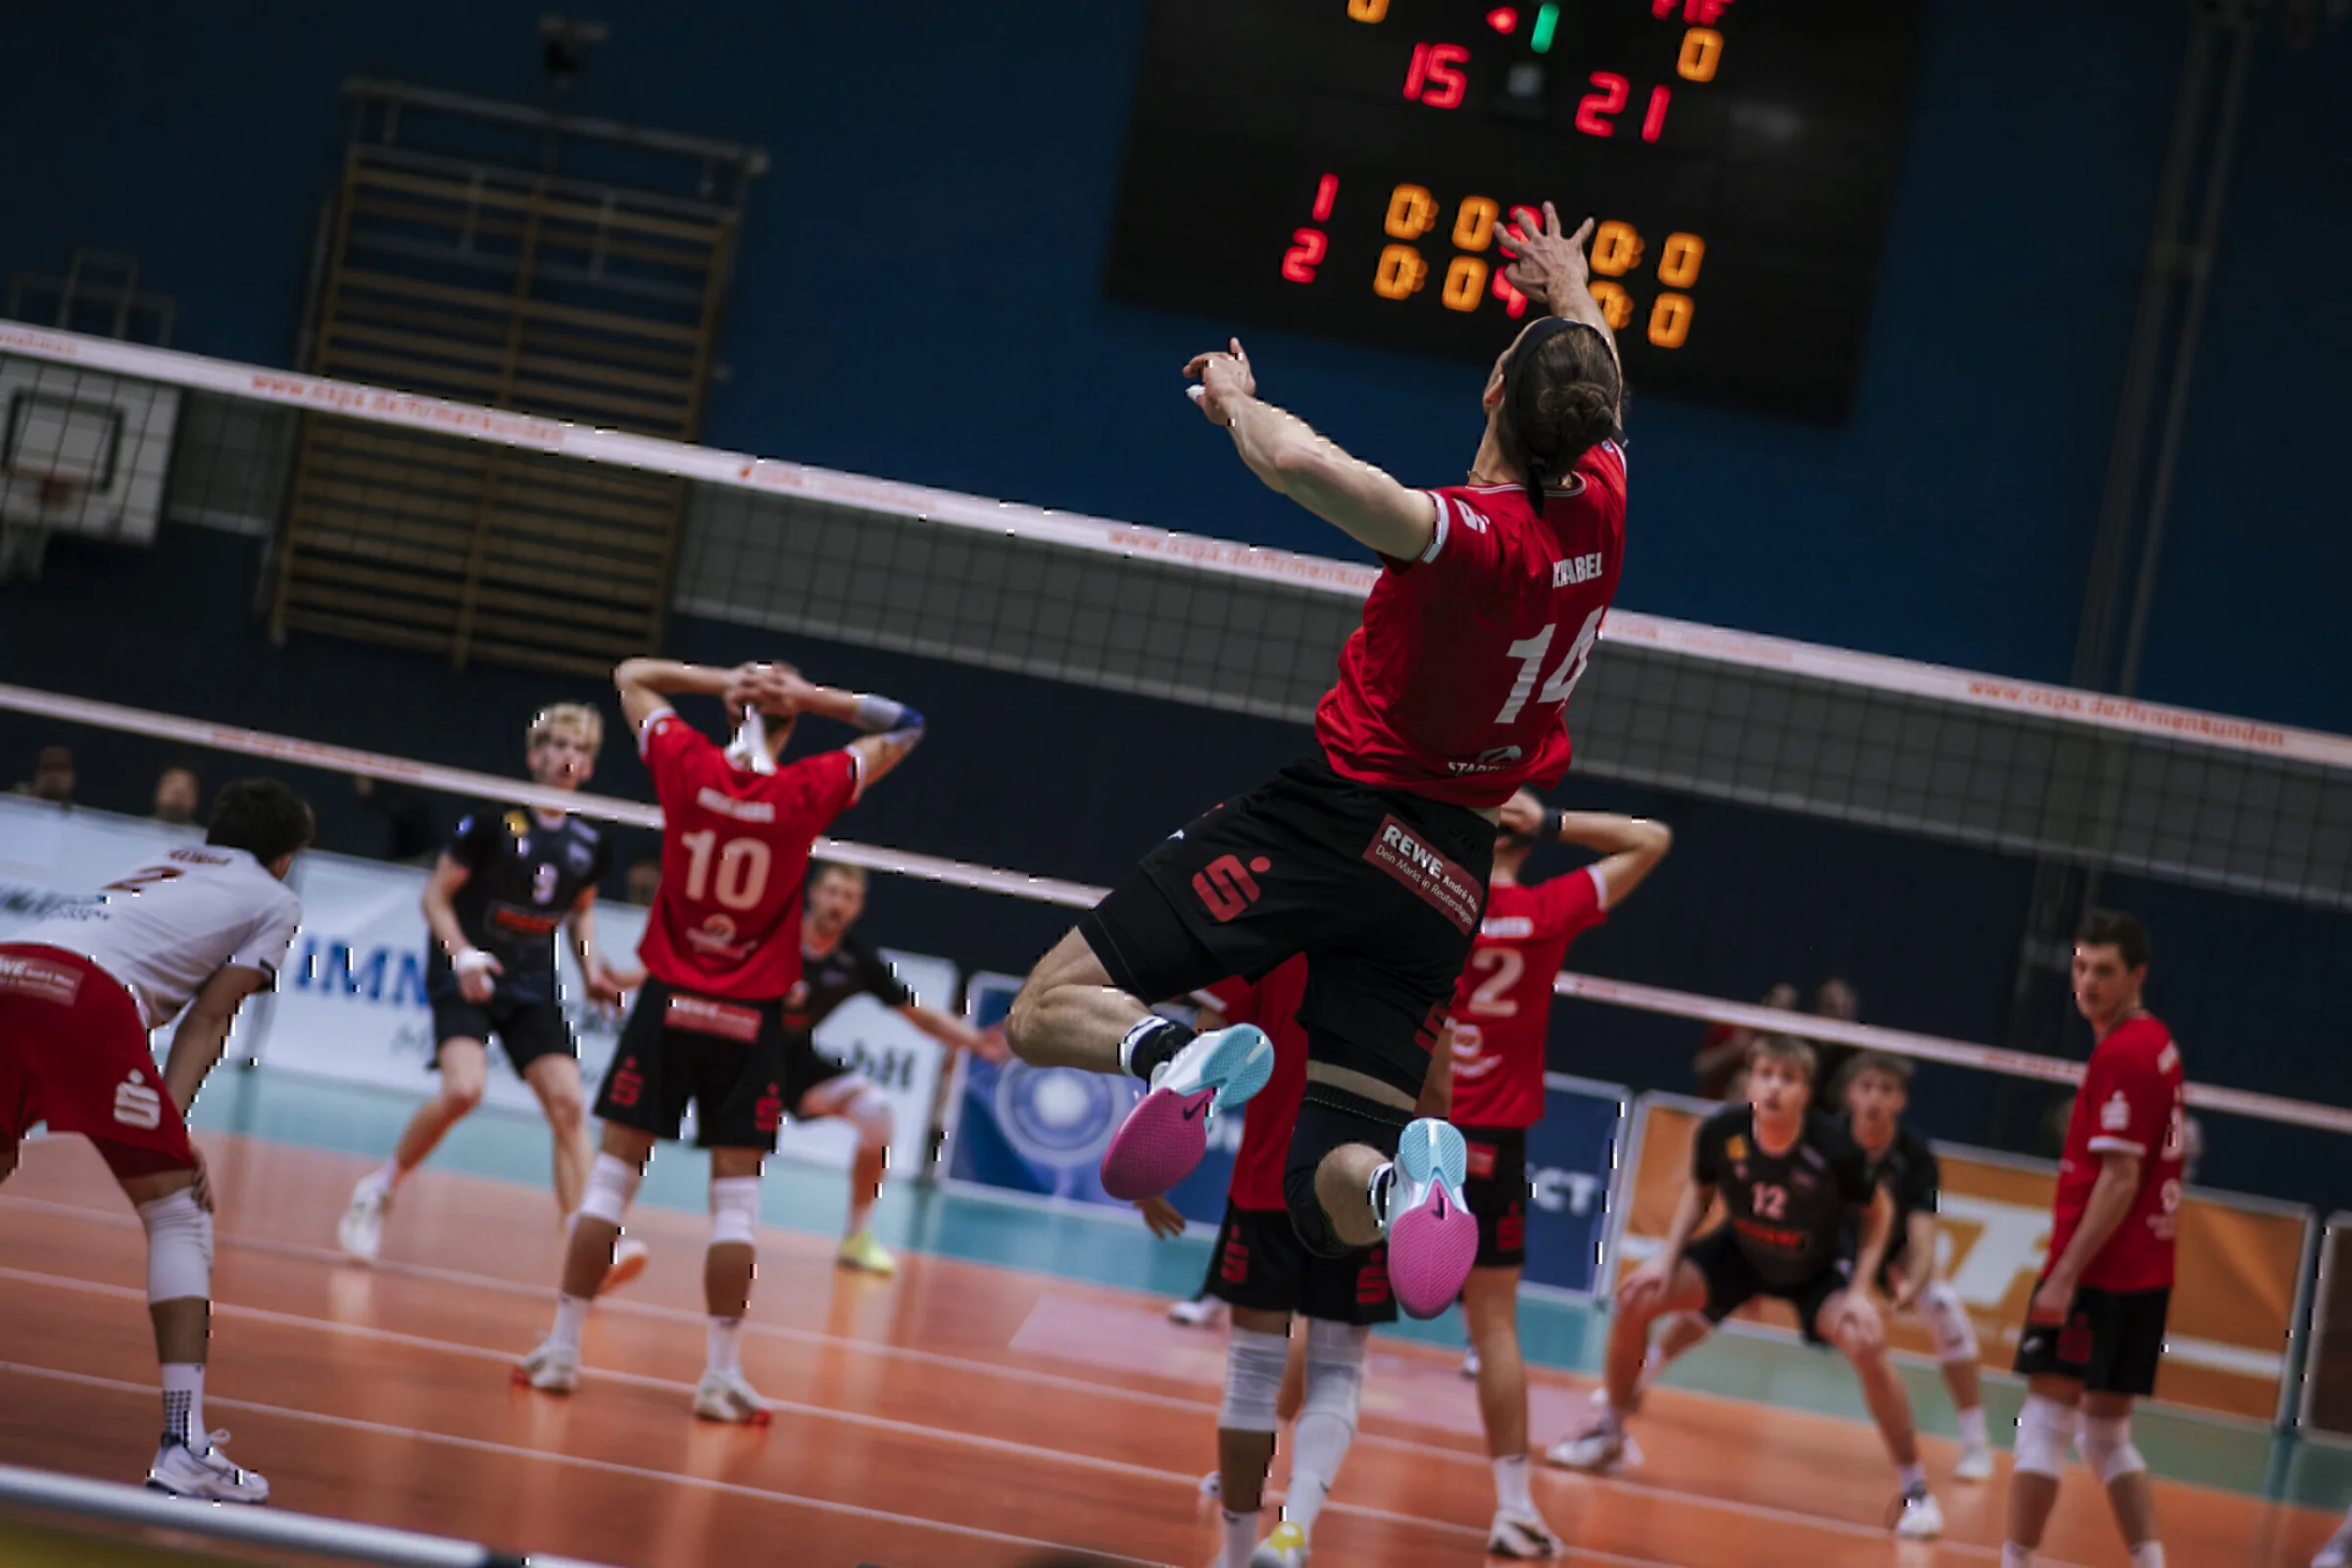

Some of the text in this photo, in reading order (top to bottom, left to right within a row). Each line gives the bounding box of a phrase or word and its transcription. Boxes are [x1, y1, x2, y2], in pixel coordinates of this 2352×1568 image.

[1677, 27, 1724, 82] 0
[1402, 41, 1672, 143] 15 21
[1312, 172, 1339, 222] 1
[1282, 227, 1329, 283] 2
[1494, 605, 1604, 723] 14
[681, 829, 772, 910] 10
[1375, 844, 1396, 863] Dein
[1396, 858, 1422, 883] Markt
[1421, 876, 1432, 890] in
[1382, 824, 1444, 880] REWE
[1442, 875, 1468, 901] André
[1468, 948, 1525, 1017] 2
[1752, 1181, 1788, 1220] 12
